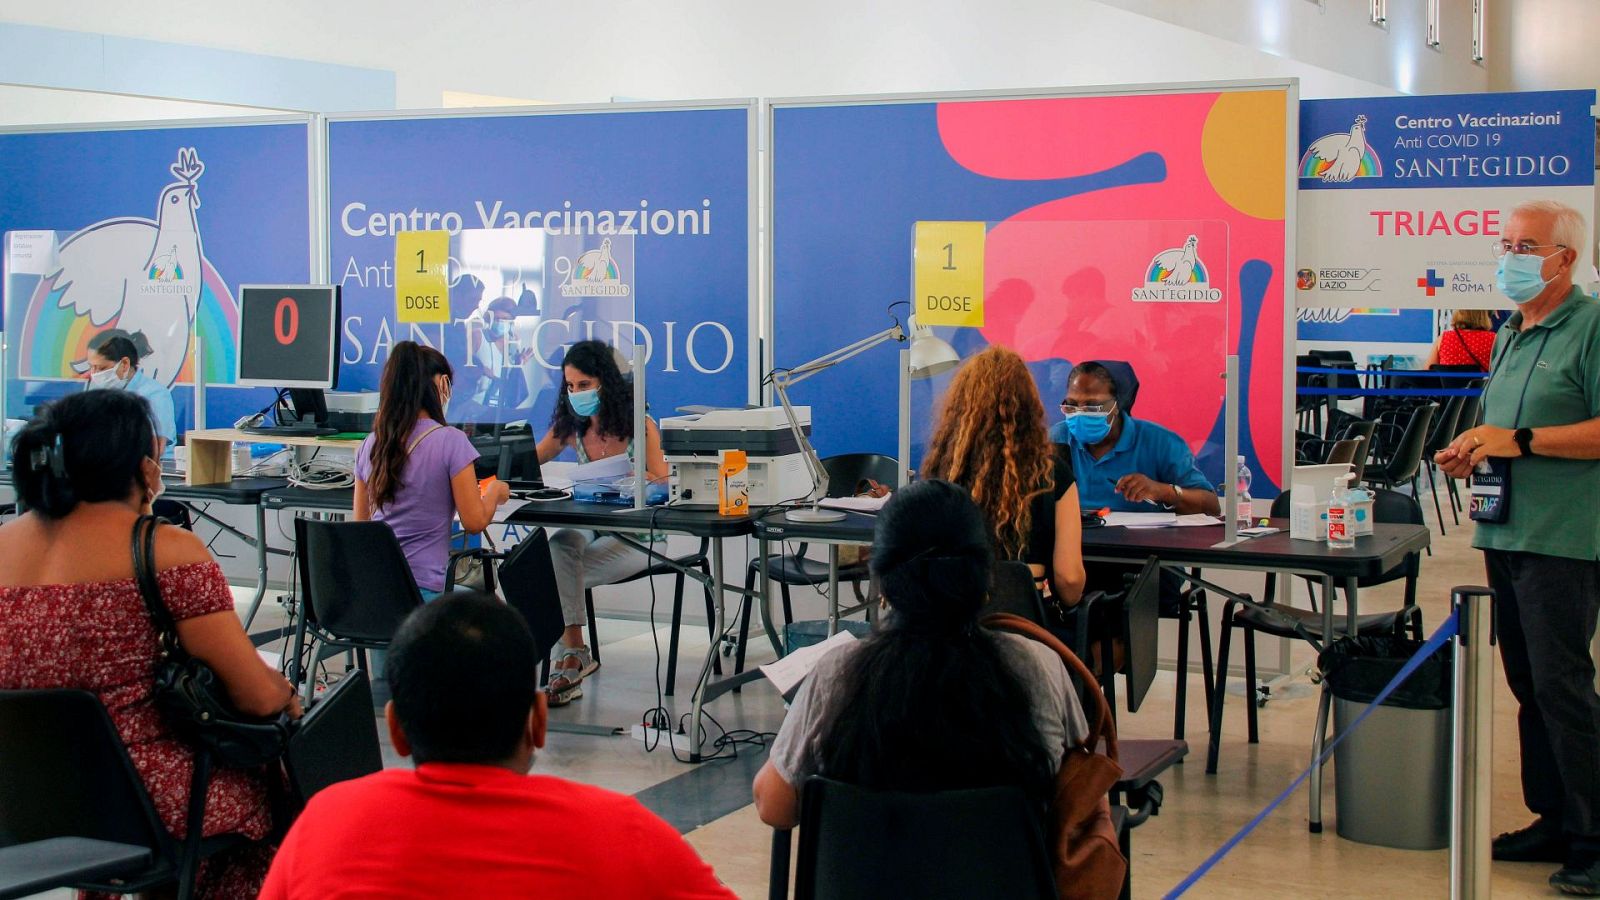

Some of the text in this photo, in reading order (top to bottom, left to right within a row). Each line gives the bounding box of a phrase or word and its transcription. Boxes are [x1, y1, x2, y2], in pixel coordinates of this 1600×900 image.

[1395, 111, 1561, 129] Centro Vaccinazioni
[1394, 133, 1501, 149] Anti COVID 19
[1394, 155, 1570, 178] SANT'EGIDIO
[341, 199, 711, 236] Centro Vaccinazioni
[1370, 210, 1500, 236] TRIAGE
[416, 250, 428, 273] 1
[942, 243, 957, 270] 1
[341, 256, 397, 288] Ant
[1320, 270, 1360, 279] REGIONE
[1452, 273, 1471, 282] ASL
[1320, 281, 1347, 289] LAZIO
[1452, 283, 1492, 293] ROMA 1
[405, 295, 440, 310] DOSE
[1133, 287, 1221, 301] SANT'EGIDIO
[927, 295, 971, 312] DOSE
[274, 297, 299, 345] 0
[1471, 496, 1500, 512] STAFF
